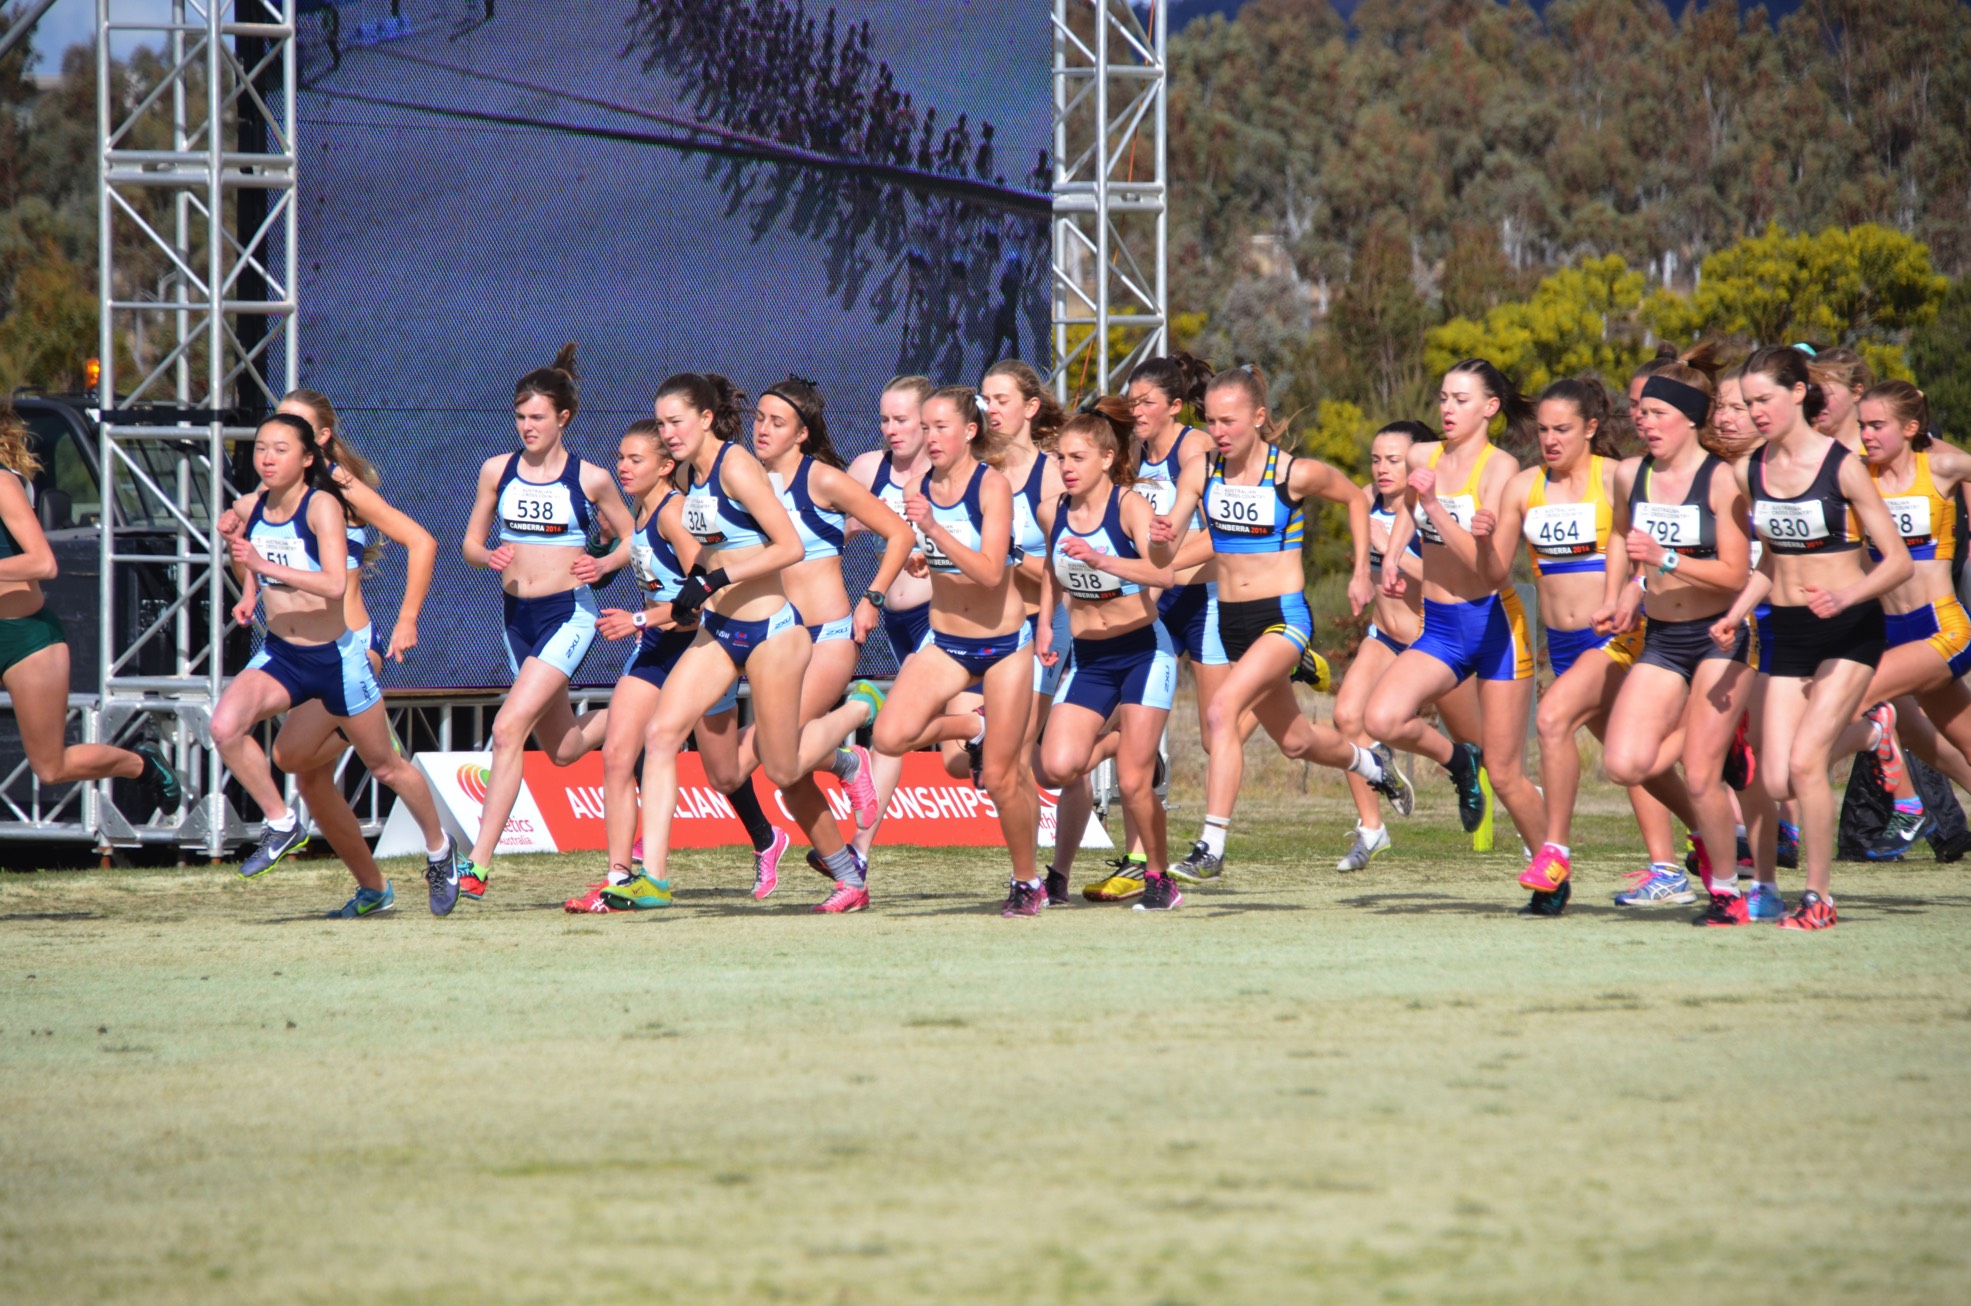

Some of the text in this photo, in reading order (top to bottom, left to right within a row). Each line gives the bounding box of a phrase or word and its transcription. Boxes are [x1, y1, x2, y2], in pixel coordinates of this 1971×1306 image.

[517, 499, 554, 520] 538
[1219, 499, 1259, 522] 306
[509, 522, 562, 533] CANBERRA 2016
[688, 510, 707, 531] 324
[1214, 521, 1268, 534] CANBERRA 2016
[1539, 520, 1580, 542] 464
[1646, 520, 1681, 542] 792
[1769, 517, 1810, 538] 830
[266, 551, 289, 567] 511
[1572, 545, 1590, 554] 2016
[1068, 572, 1102, 589] 518
[565, 633, 580, 660] 2XU
[565, 786, 736, 819] AULIAN
[774, 786, 999, 822] CMONSHIPS
